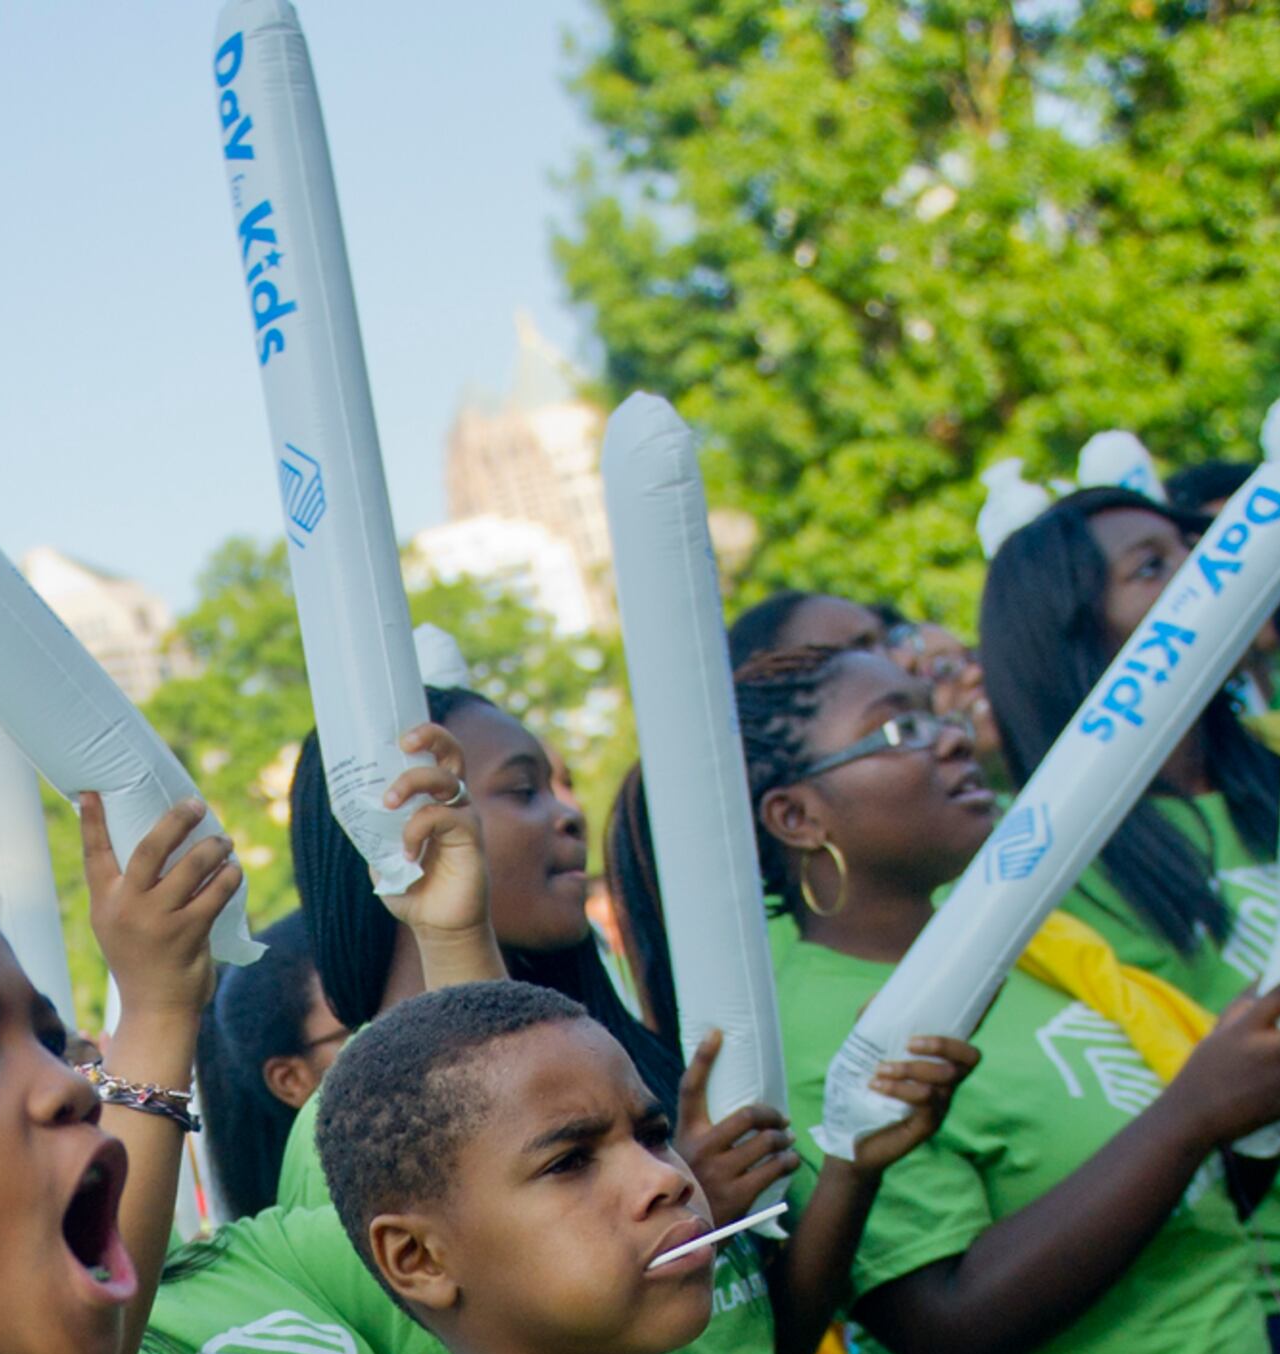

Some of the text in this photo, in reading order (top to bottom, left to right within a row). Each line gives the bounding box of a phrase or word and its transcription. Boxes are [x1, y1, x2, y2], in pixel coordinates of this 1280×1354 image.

[214, 31, 256, 160] Day
[237, 199, 298, 367] Kids
[1079, 622, 1197, 742] Kids
